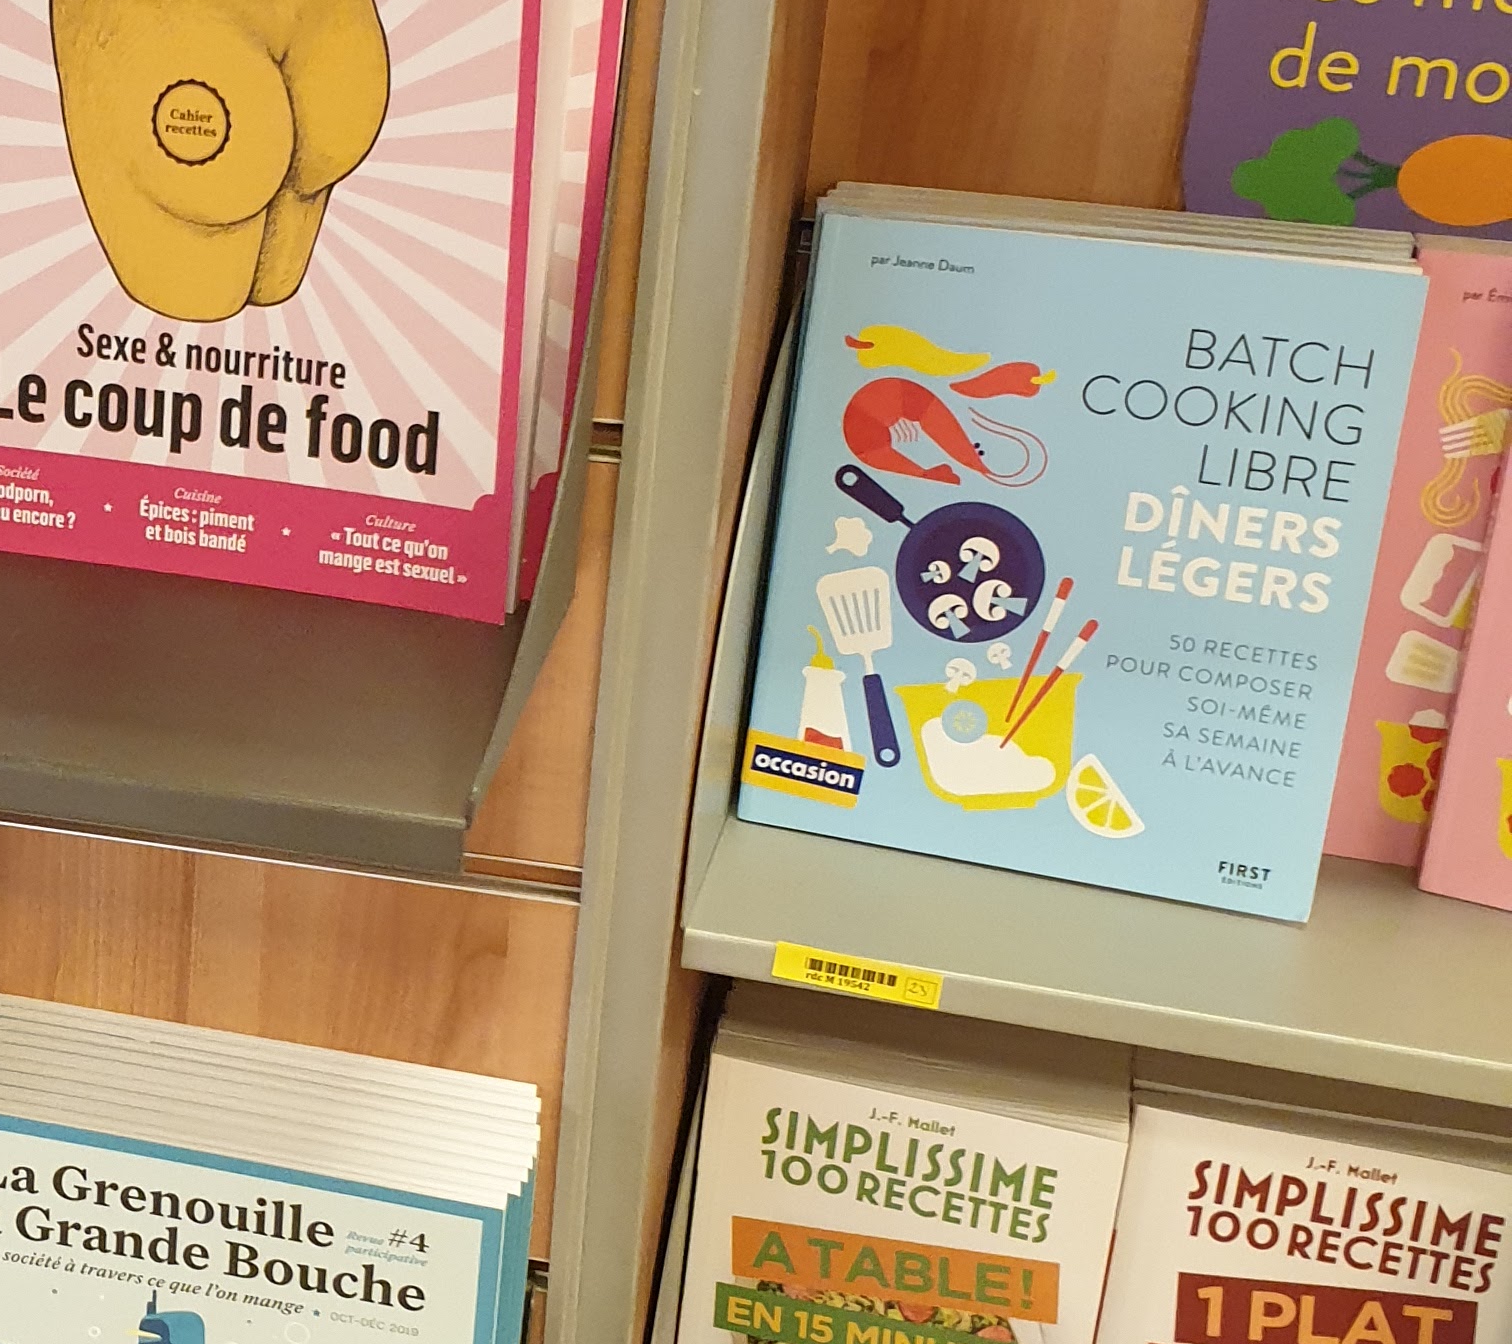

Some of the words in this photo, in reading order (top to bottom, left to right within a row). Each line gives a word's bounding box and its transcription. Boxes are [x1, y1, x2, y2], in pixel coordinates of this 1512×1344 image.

[1269, 20, 1359, 93] de
[165, 123, 217, 138] recettes
[169, 108, 213, 124] Cahier
[77, 322, 146, 365] Sexe
[155, 330, 177, 368] &
[185, 339, 347, 389] nourriture
[1184, 328, 1375, 390] BATCH
[63, 375, 203, 453] coup
[220, 384, 287, 454] de
[305, 393, 441, 476] food
[1081, 374, 1365, 446] COOKING
[1196, 444, 1357, 503] LIBRE
[13, 507, 64, 529] encore
[1123, 485, 1343, 560] DÎNERS
[1116, 540, 1332, 615] LÉGERS
[1105, 653, 1173, 683] POUR
[1178, 663, 1313, 702] COMPOSER
[1169, 633, 1196, 654] 50
[1202, 638, 1319, 673] RECETTES
[1162, 720, 1192, 742] SA
[1199, 725, 1302, 761] SEMAINE
[1186, 694, 1307, 731] SOI-MÊME
[754, 749, 856, 789] occasion
[1217, 858, 1272, 883] FIRST
[760, 1106, 1059, 1212] SIMPLISSIME
[52, 1163, 335, 1249] Grenouille
[387, 1227, 430, 1255] #4
[760, 1149, 849, 1197] 100
[855, 1167, 1051, 1245] RECETTES
[1190, 1158, 1507, 1260] SIMPLISSIME
[15, 1204, 210, 1272] Grande
[223, 1239, 427, 1313] Bouche
[753, 1231, 797, 1278] A
[810, 1236, 1037, 1312] TABLE!
[1187, 1204, 1281, 1253] 100
[1288, 1220, 1496, 1295] RECETTES
[726, 1297, 787, 1335] EN
[795, 1308, 834, 1343] 15
[1196, 1285, 1224, 1338] 1
